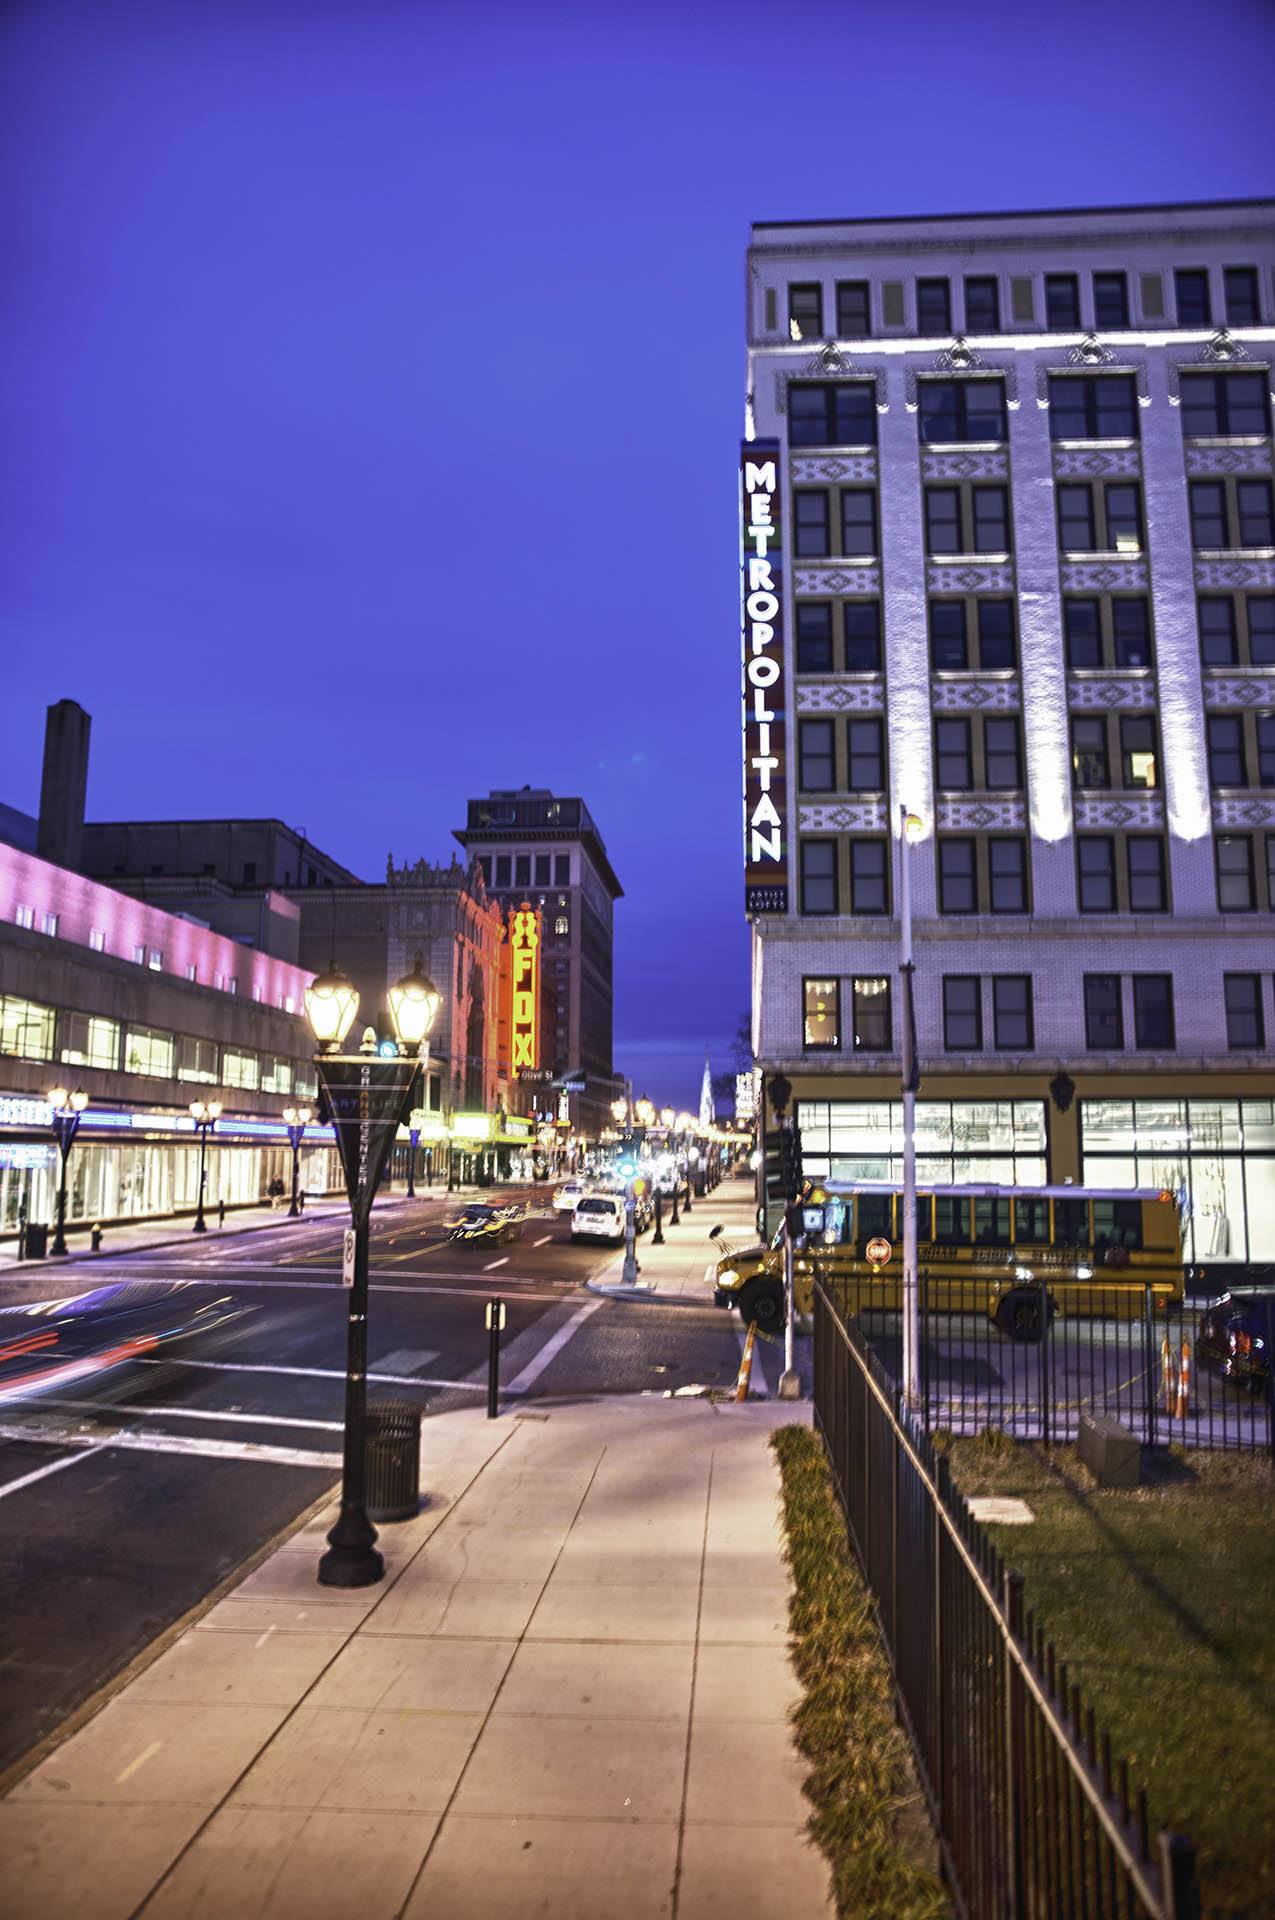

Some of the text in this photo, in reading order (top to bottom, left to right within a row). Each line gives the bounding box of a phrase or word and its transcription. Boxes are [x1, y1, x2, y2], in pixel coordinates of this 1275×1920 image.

[746, 461, 782, 863] METROPOLITAN
[750, 899, 784, 910] LOFTS
[515, 948, 533, 1067] FOX
[521, 1069, 553, 1081] Olive St
[358, 1121, 369, 1186] CENTER
